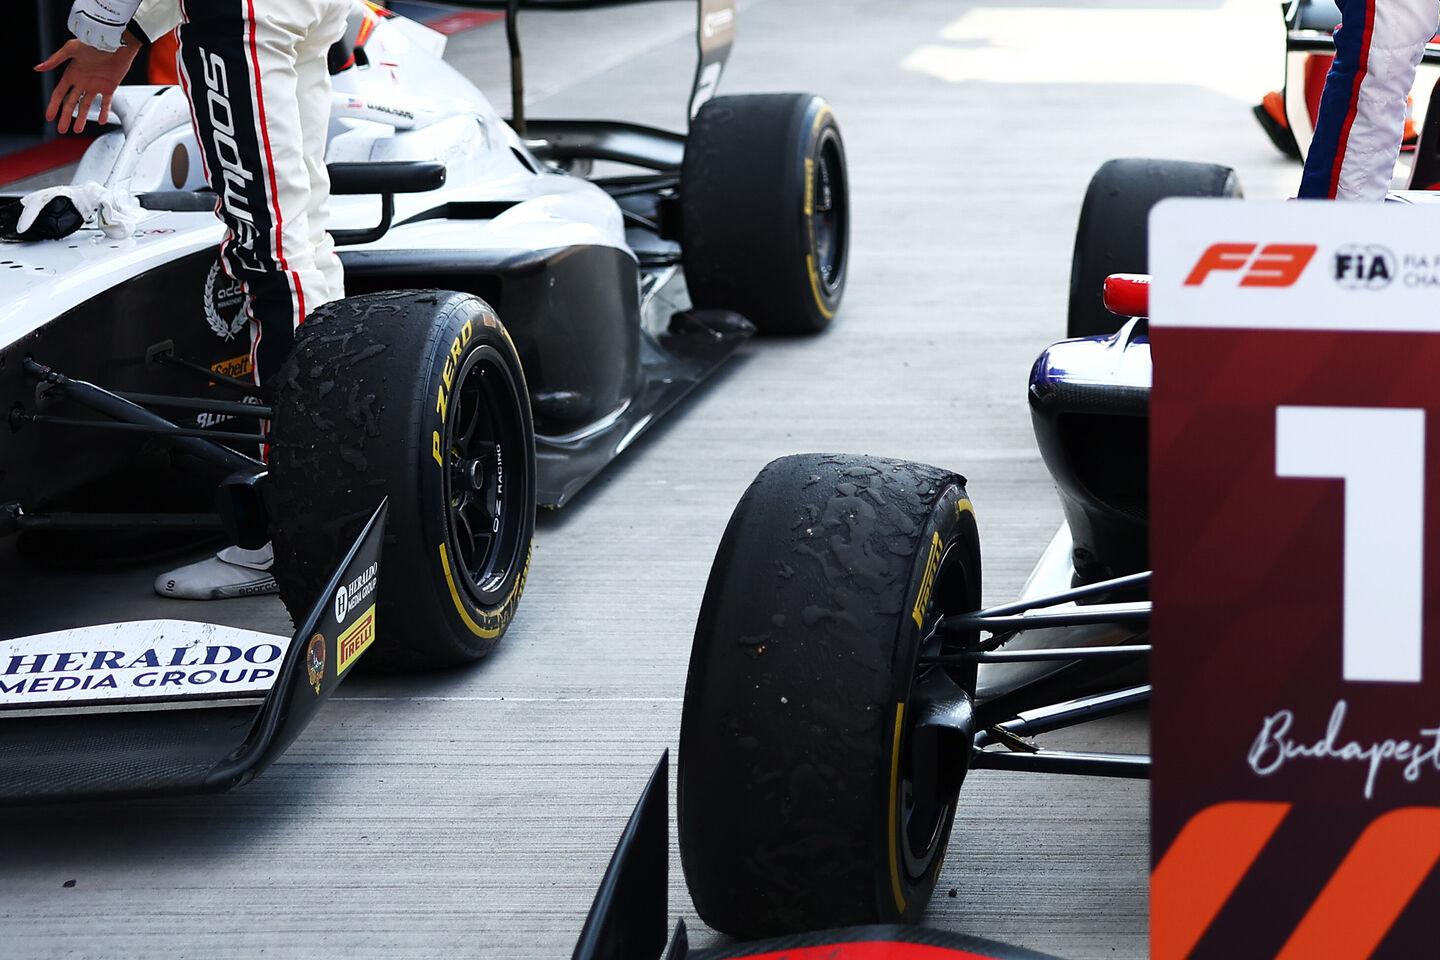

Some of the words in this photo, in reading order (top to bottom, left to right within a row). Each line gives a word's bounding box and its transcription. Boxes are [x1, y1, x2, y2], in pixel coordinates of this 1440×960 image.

[1183, 243, 1318, 287] F3
[436, 319, 473, 424] ZERO
[495, 443, 503, 494] RACING
[1275, 405, 1425, 683] 1
[348, 561, 378, 598] HERALDO
[1, 643, 283, 676] HERALDO
[341, 614, 373, 665] PIRELLI
[0, 674, 118, 694] MEDIA
[133, 668, 275, 688] GROUP
